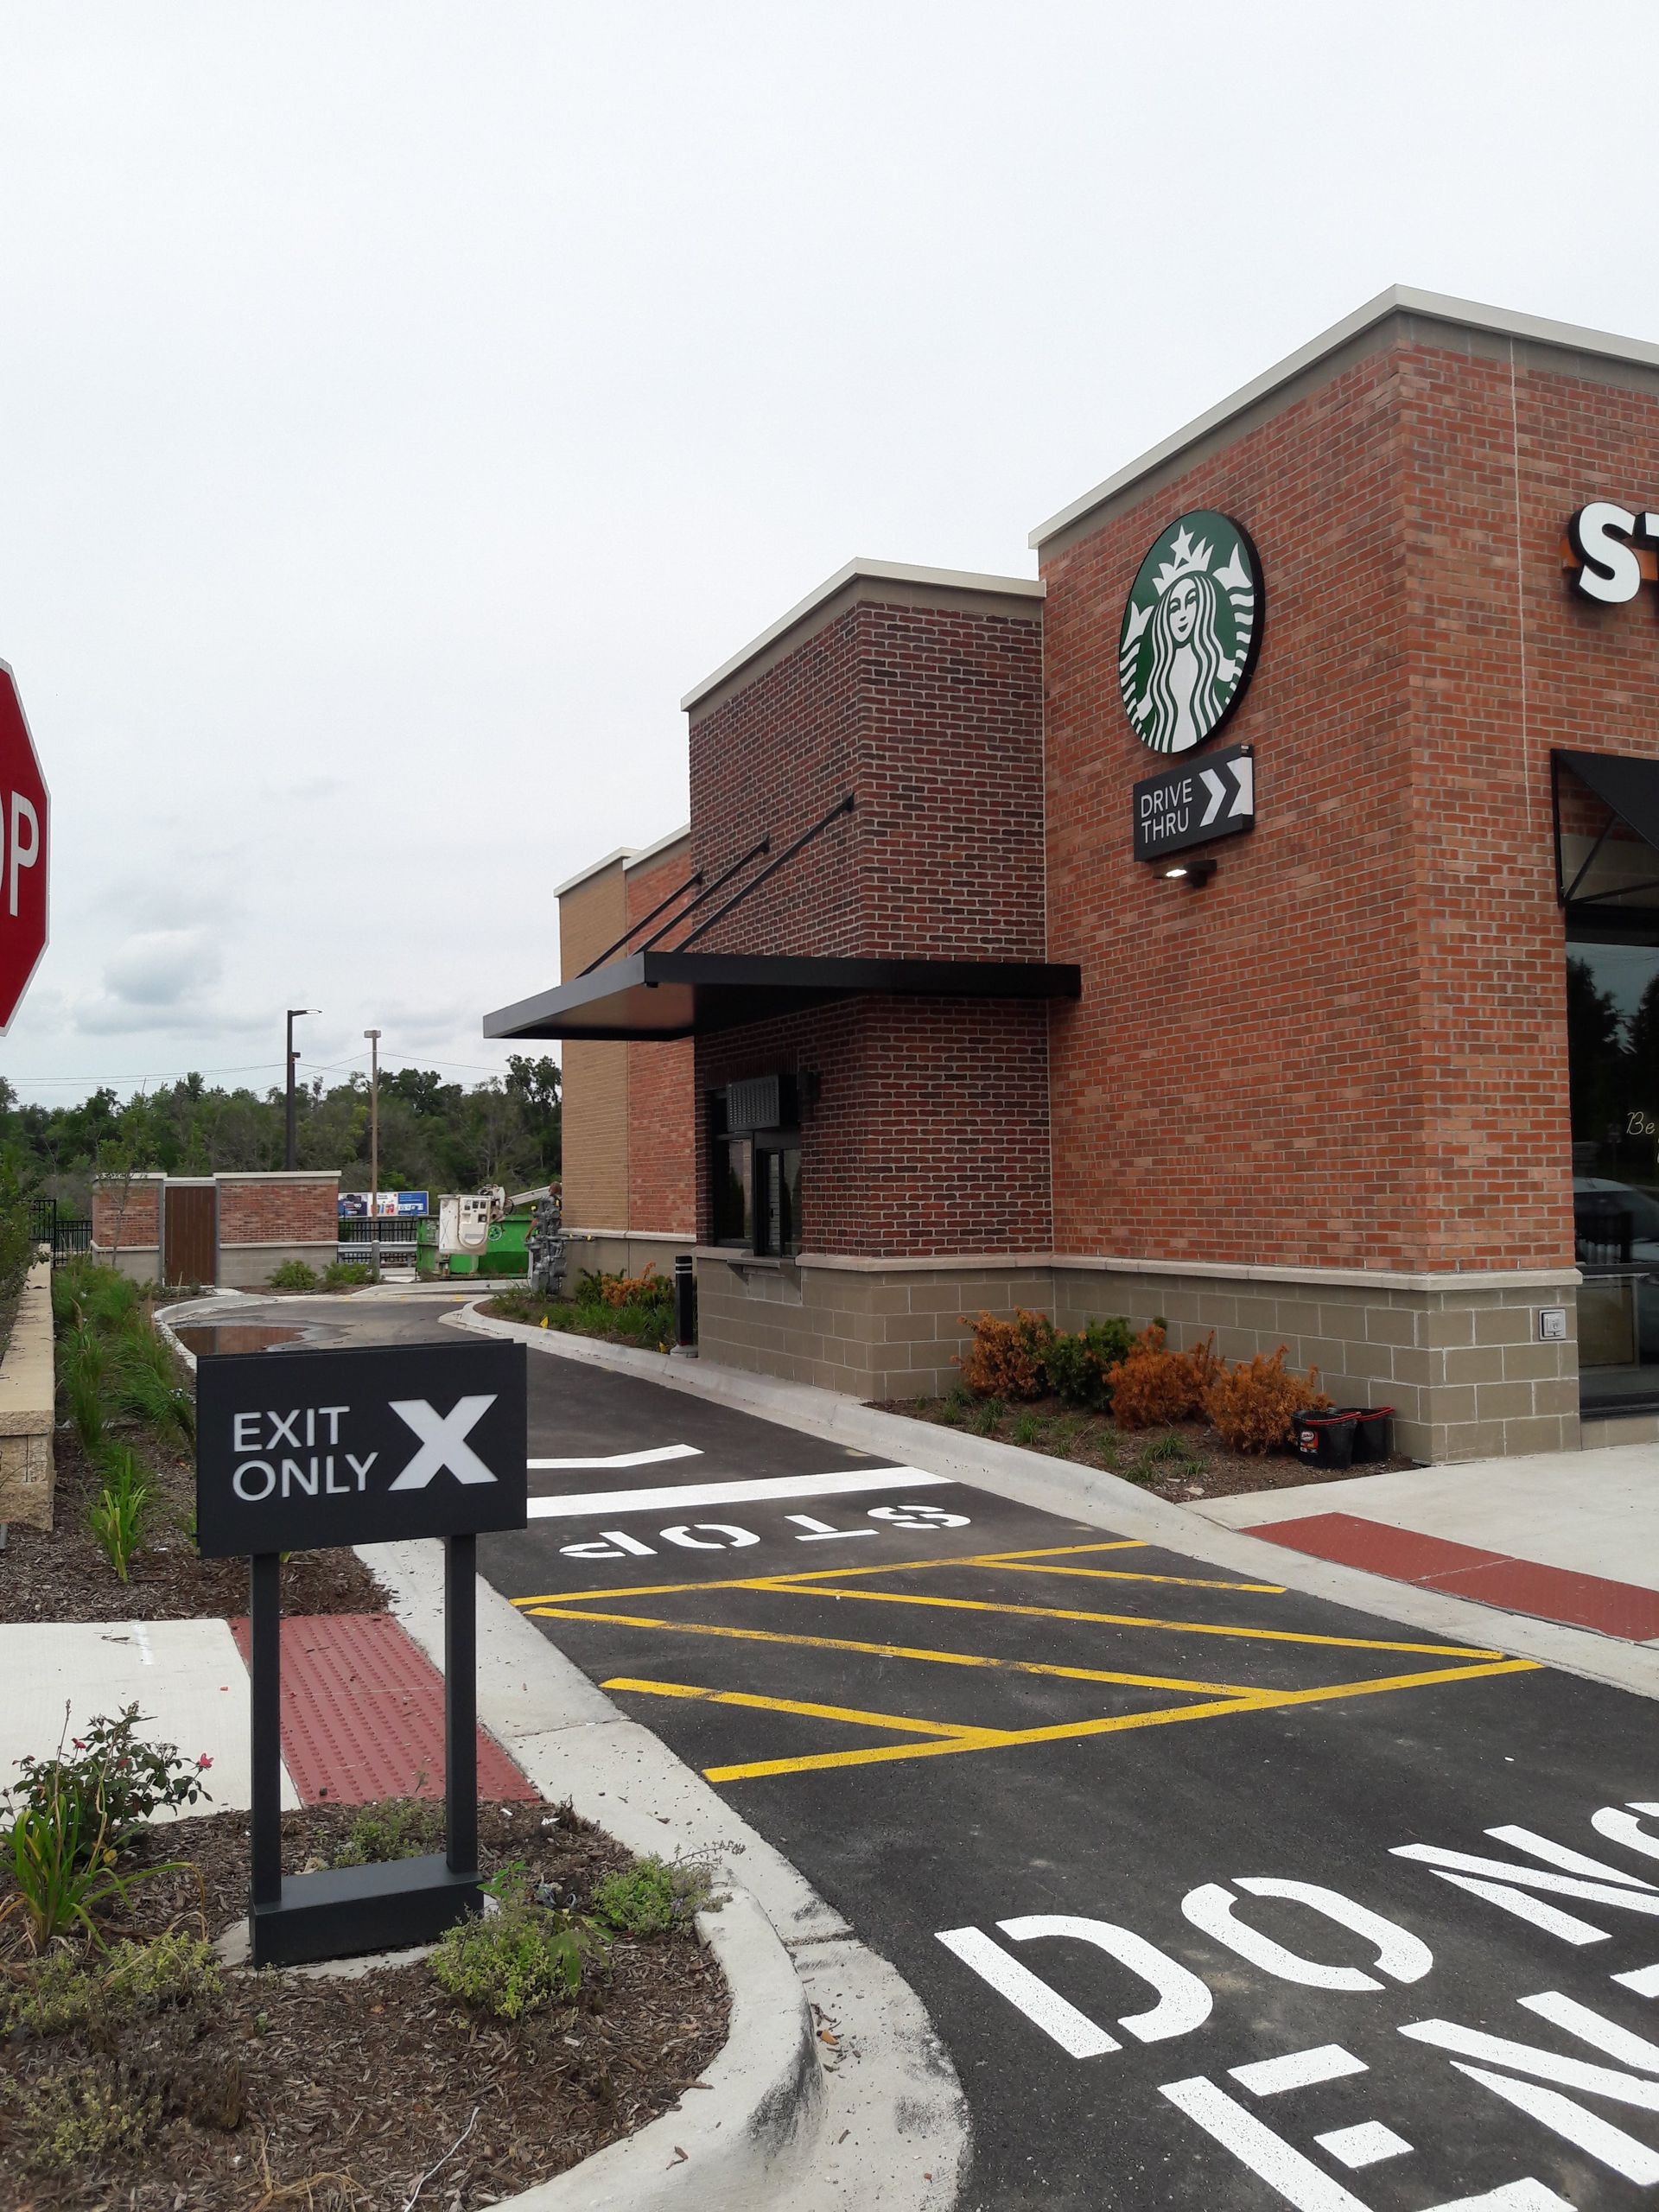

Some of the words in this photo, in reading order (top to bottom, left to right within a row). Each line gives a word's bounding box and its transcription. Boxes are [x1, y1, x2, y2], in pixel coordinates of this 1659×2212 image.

[1576, 500, 1659, 603] S
[1141, 778, 1193, 818] DRIVE
[1141, 806, 1190, 844] THRU
[0, 790, 40, 918] P
[233, 1405, 350, 1452] EXIT
[232, 1452, 379, 1502] ONLY
[558, 1504, 971, 1559] STOP
[934, 1876, 1434, 2060] DO
[1387, 1802, 1659, 1947] N
[1157, 1963, 1659, 2212] EN
